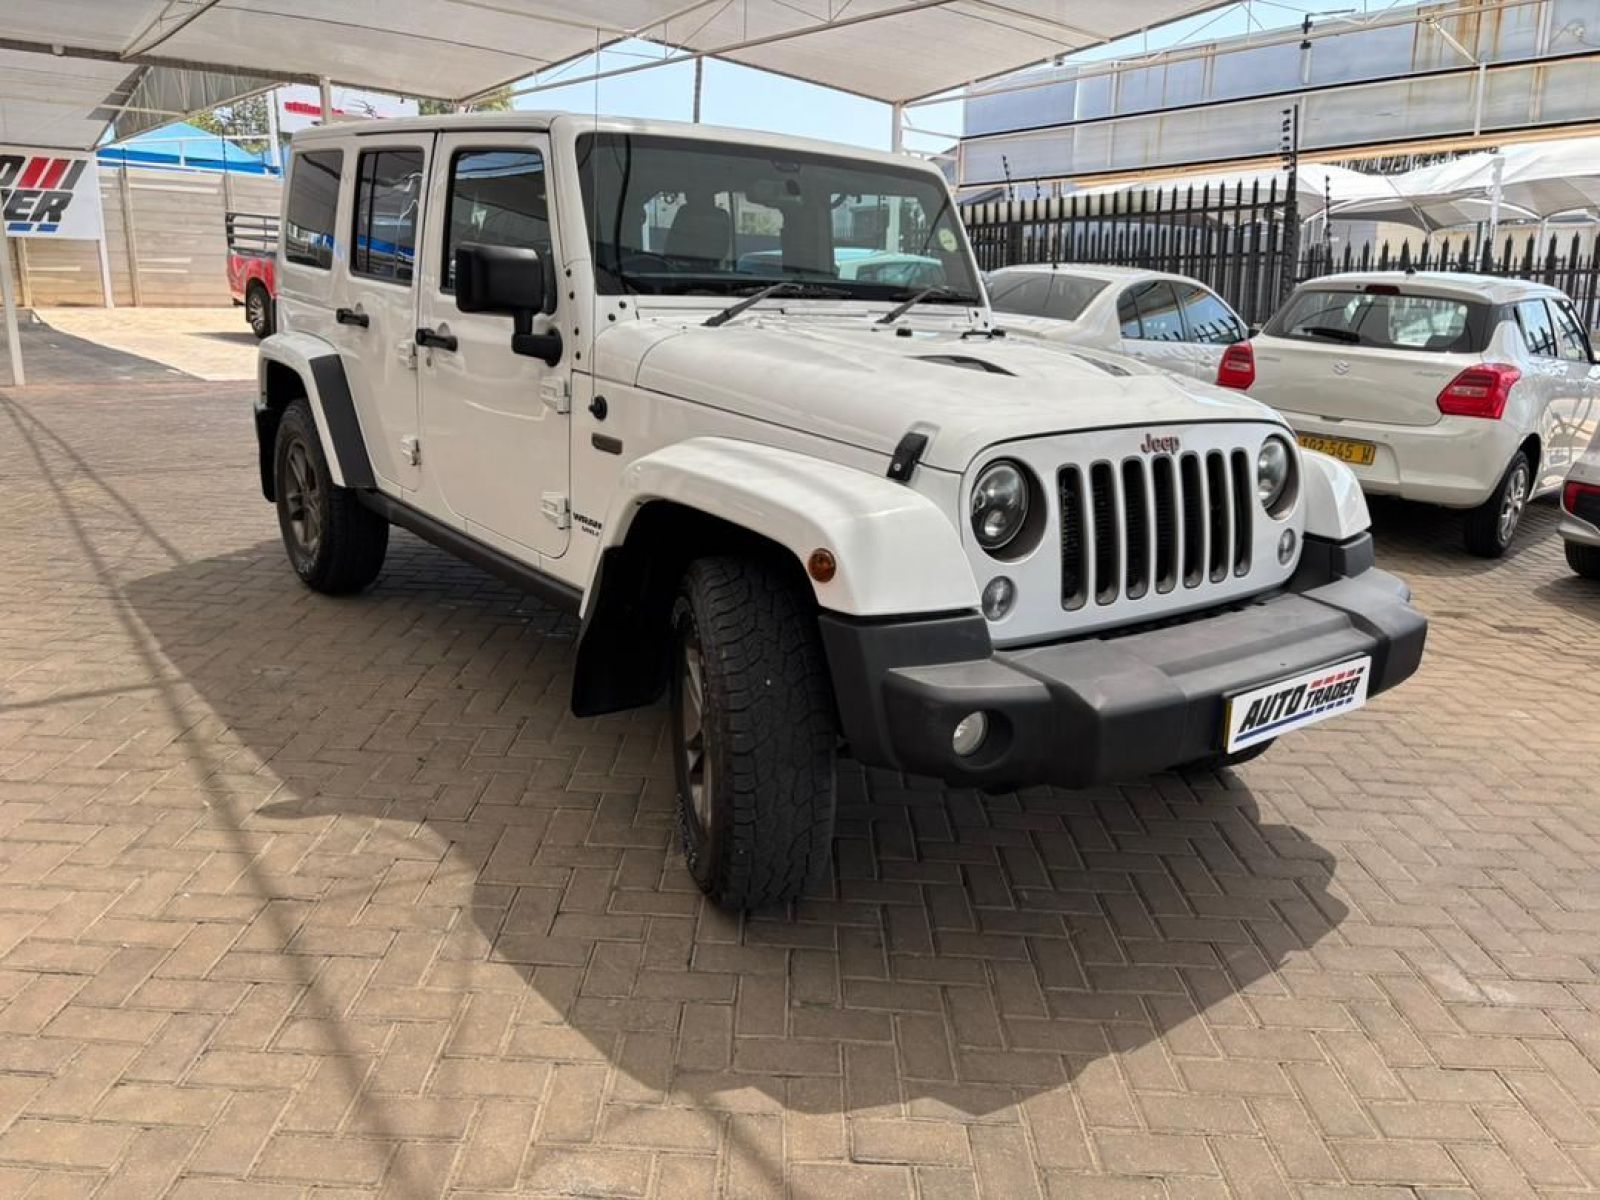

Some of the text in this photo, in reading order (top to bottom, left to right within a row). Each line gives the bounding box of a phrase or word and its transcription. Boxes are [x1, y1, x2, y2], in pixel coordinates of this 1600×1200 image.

[1140, 433, 1180, 455] Jeep
[1238, 676, 1361, 733] AUTO TRADER
